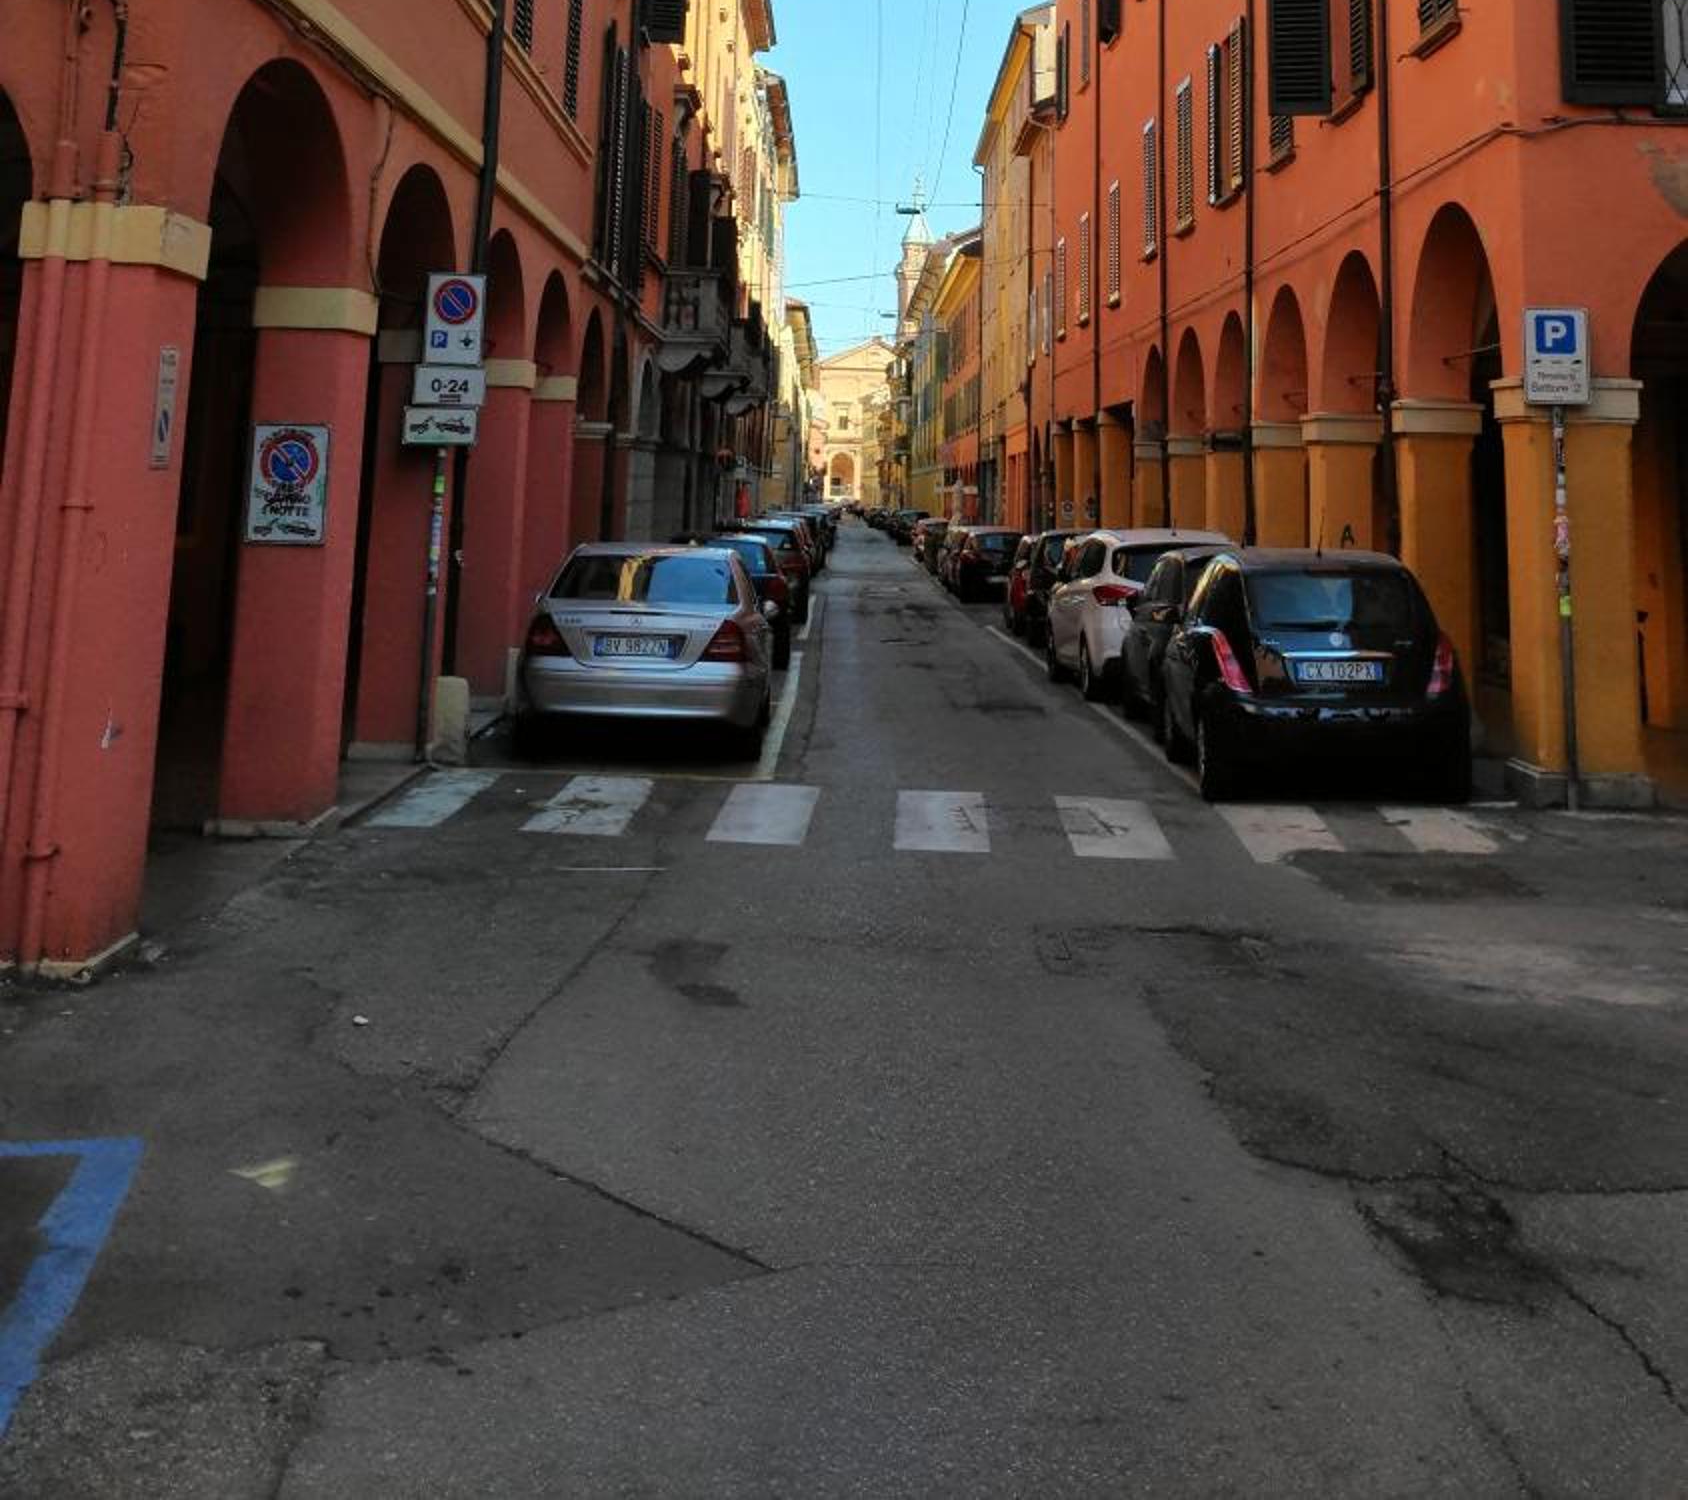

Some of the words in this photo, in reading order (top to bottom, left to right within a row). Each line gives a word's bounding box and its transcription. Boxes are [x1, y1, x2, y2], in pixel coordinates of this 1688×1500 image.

[433, 332, 444, 348] P
[1543, 320, 1567, 348] P
[431, 379, 469, 393] 0-24
